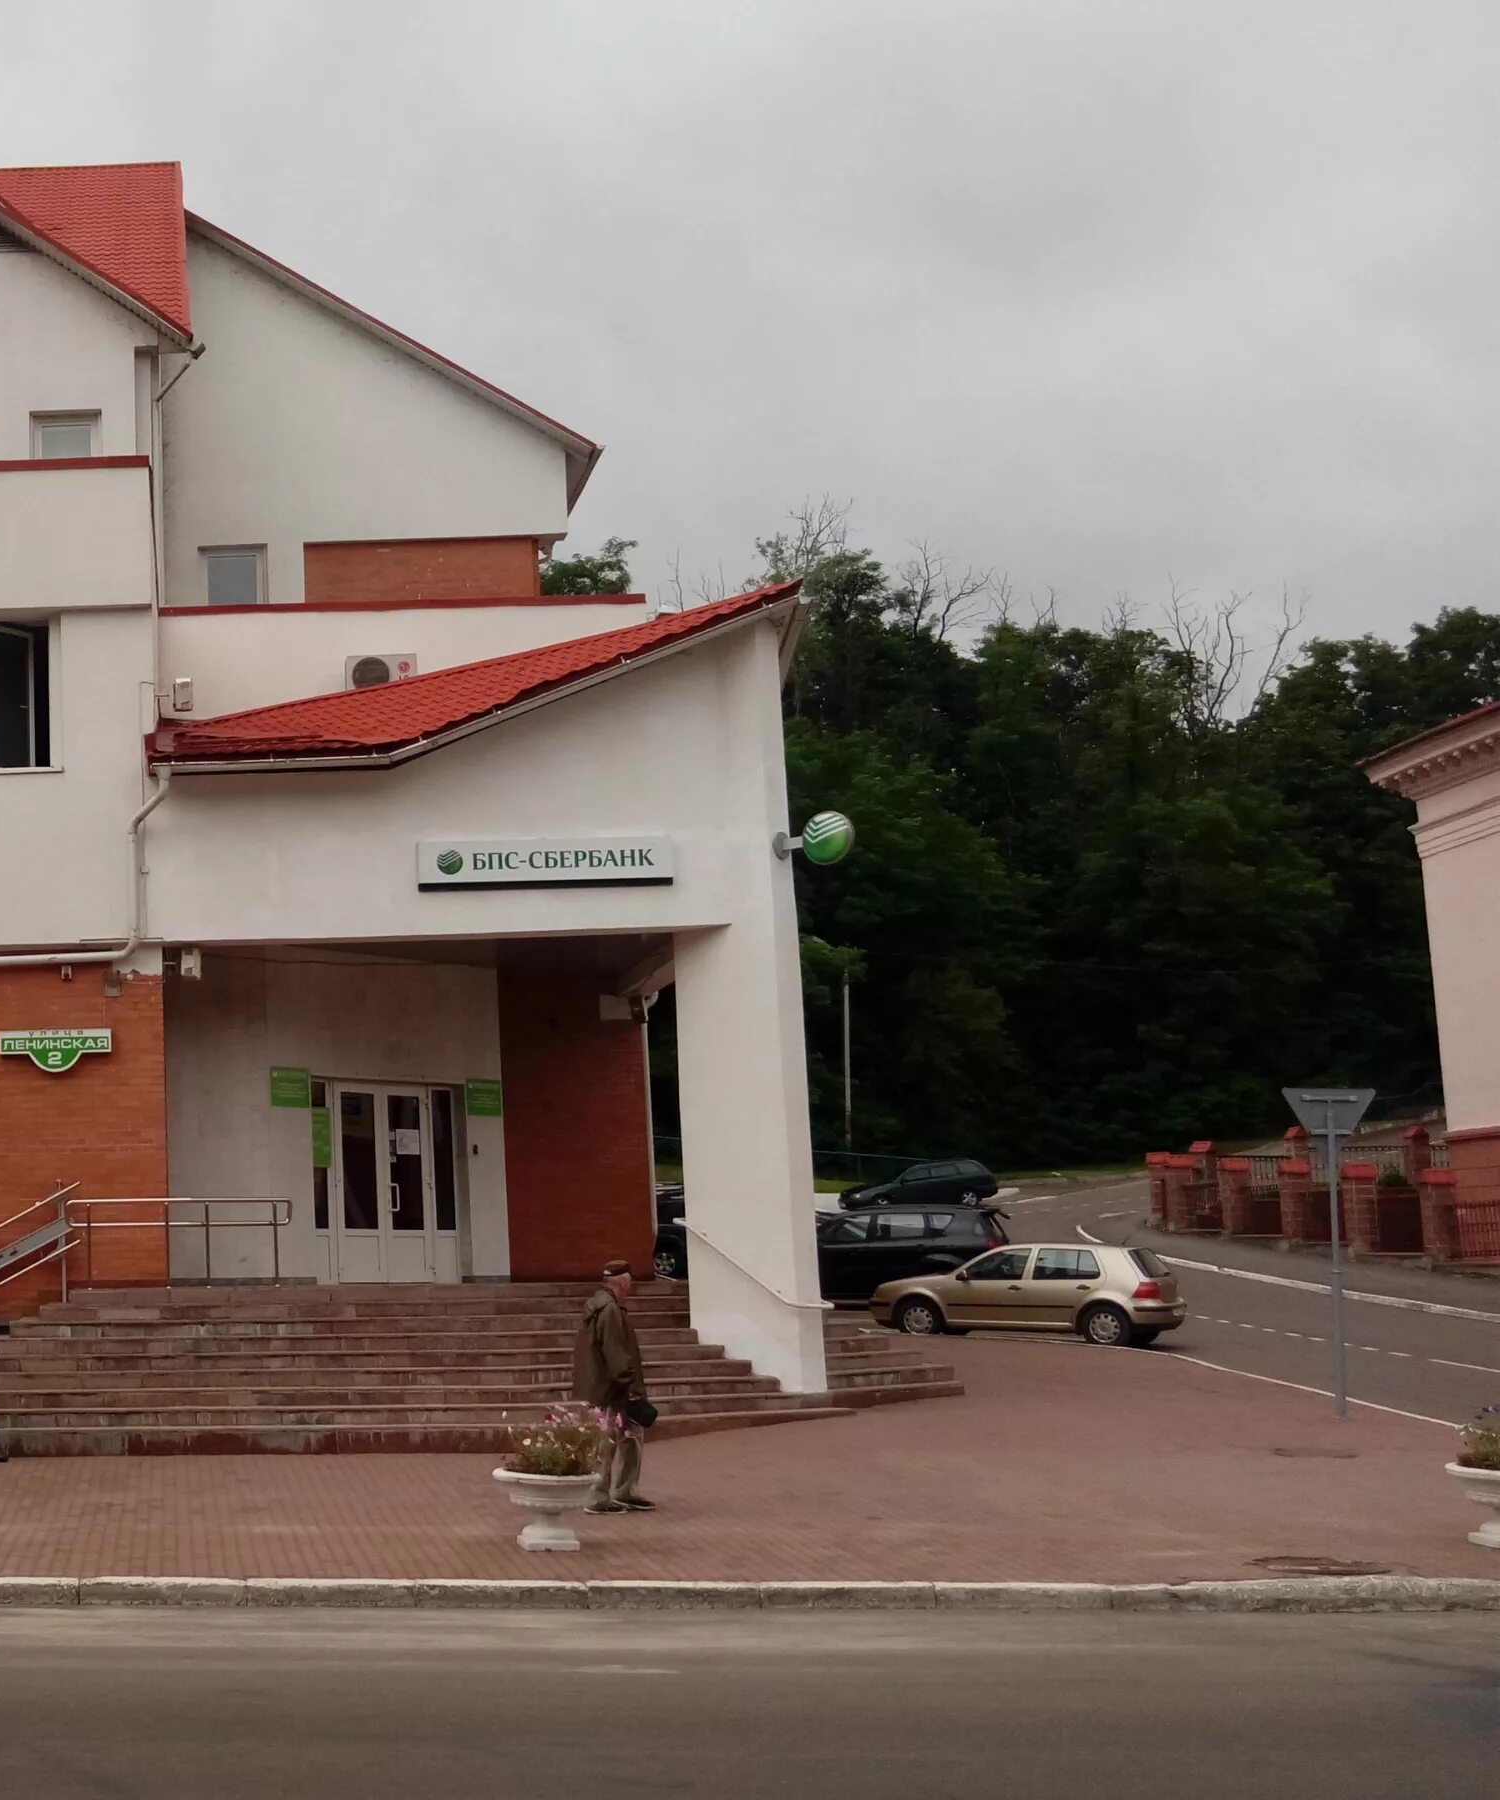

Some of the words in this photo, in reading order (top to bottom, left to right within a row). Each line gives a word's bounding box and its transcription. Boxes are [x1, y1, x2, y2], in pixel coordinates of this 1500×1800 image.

[472, 848, 655, 870] БПС-СБЕРБАНК
[3, 1038, 109, 1050] ЛЕНИНСКАЯ
[47, 1051, 62, 1065] 2
